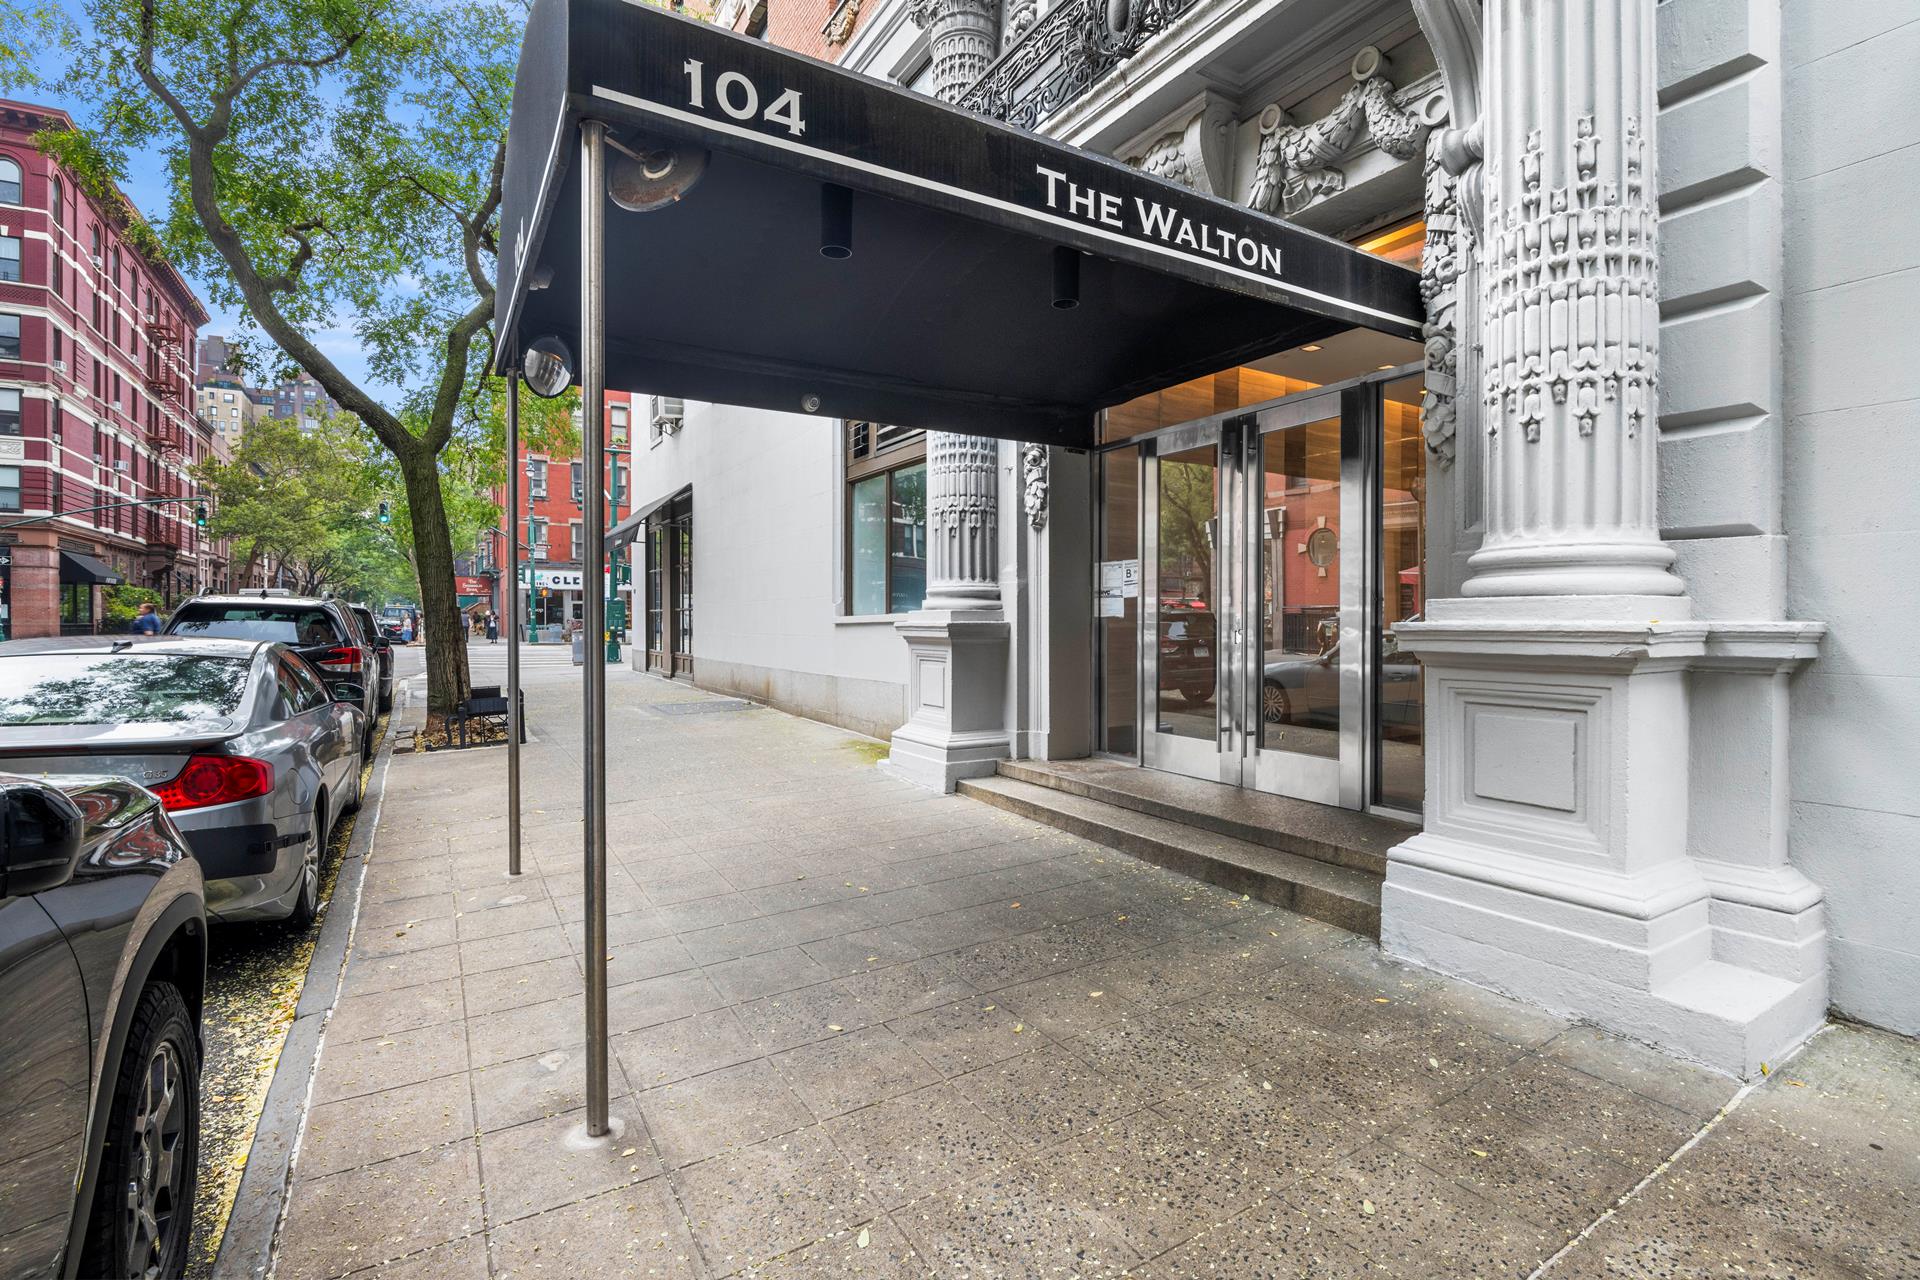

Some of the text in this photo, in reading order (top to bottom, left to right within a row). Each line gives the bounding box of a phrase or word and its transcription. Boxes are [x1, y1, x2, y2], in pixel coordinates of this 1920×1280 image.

[683, 58, 805, 136] 104
[1036, 164, 1282, 275] THE WALTON
[142, 769, 168, 778] G35
